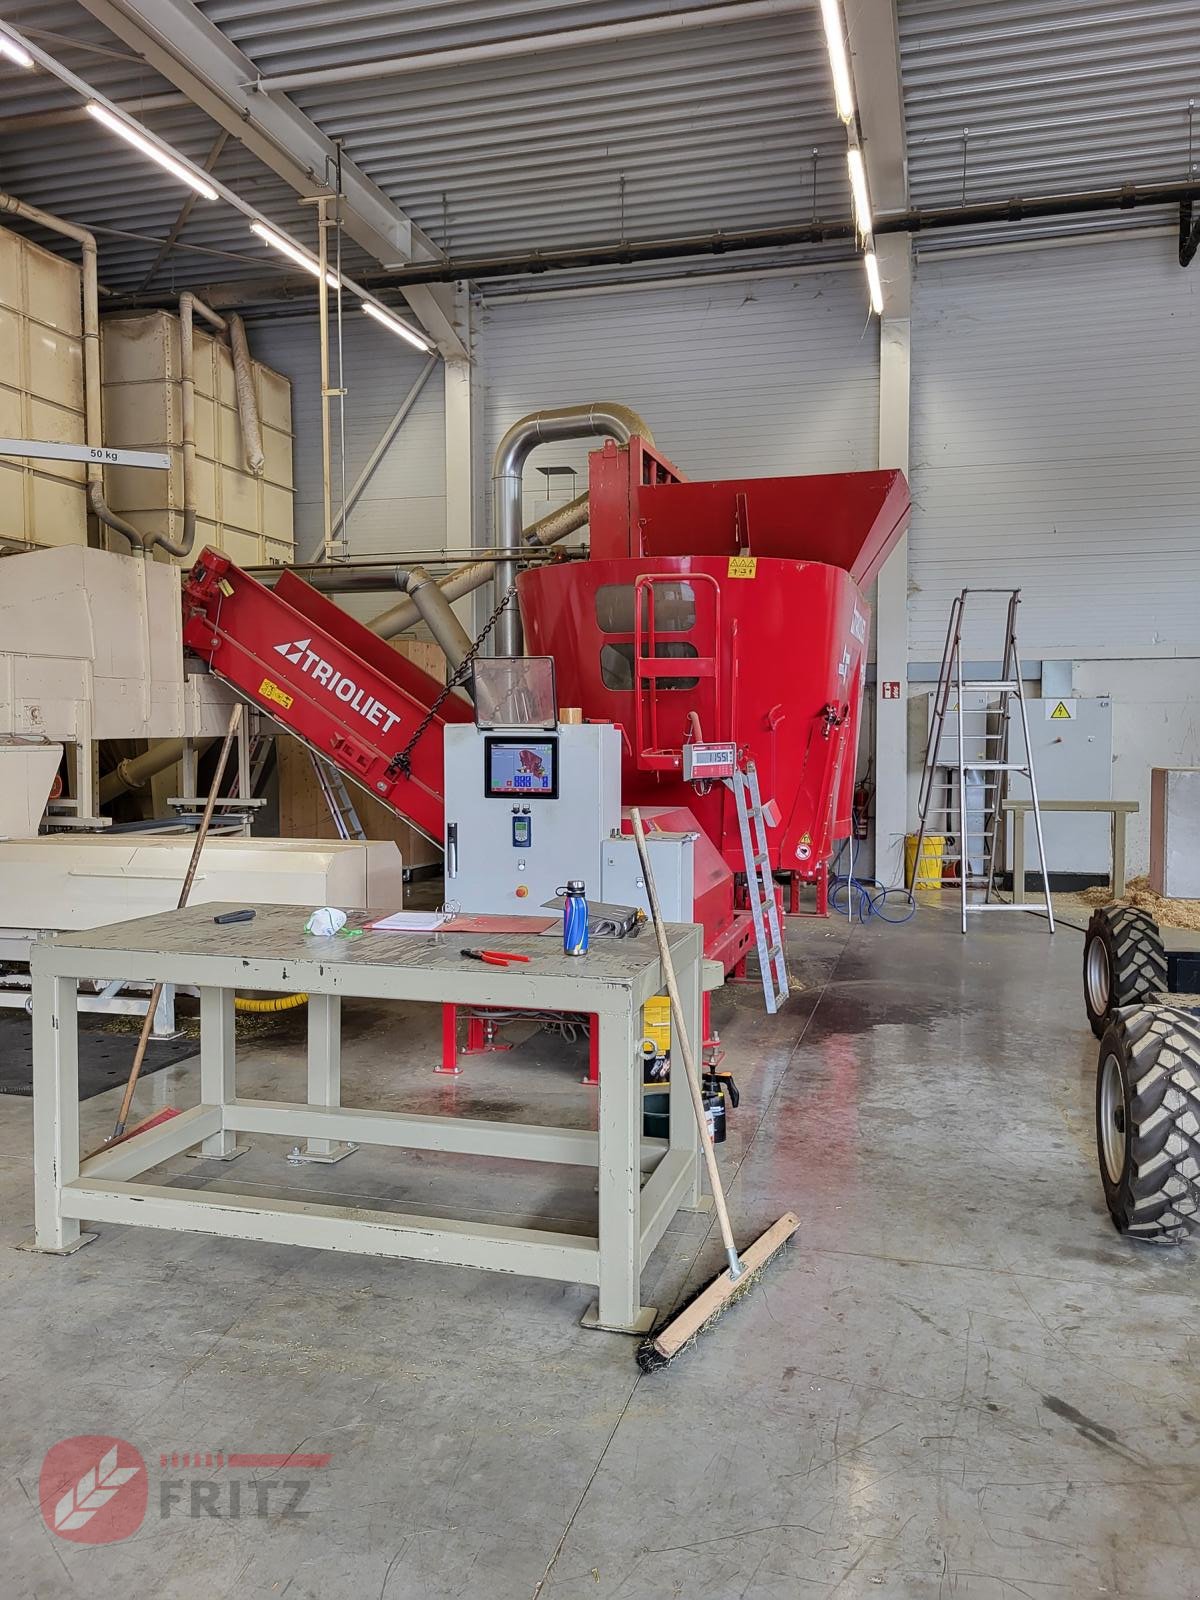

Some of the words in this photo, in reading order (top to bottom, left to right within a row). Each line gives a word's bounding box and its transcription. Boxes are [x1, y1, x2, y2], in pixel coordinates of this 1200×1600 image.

[90, 449, 102, 458] 50
[105, 450, 118, 461] kg
[301, 649, 401, 733] TRIOLIET
